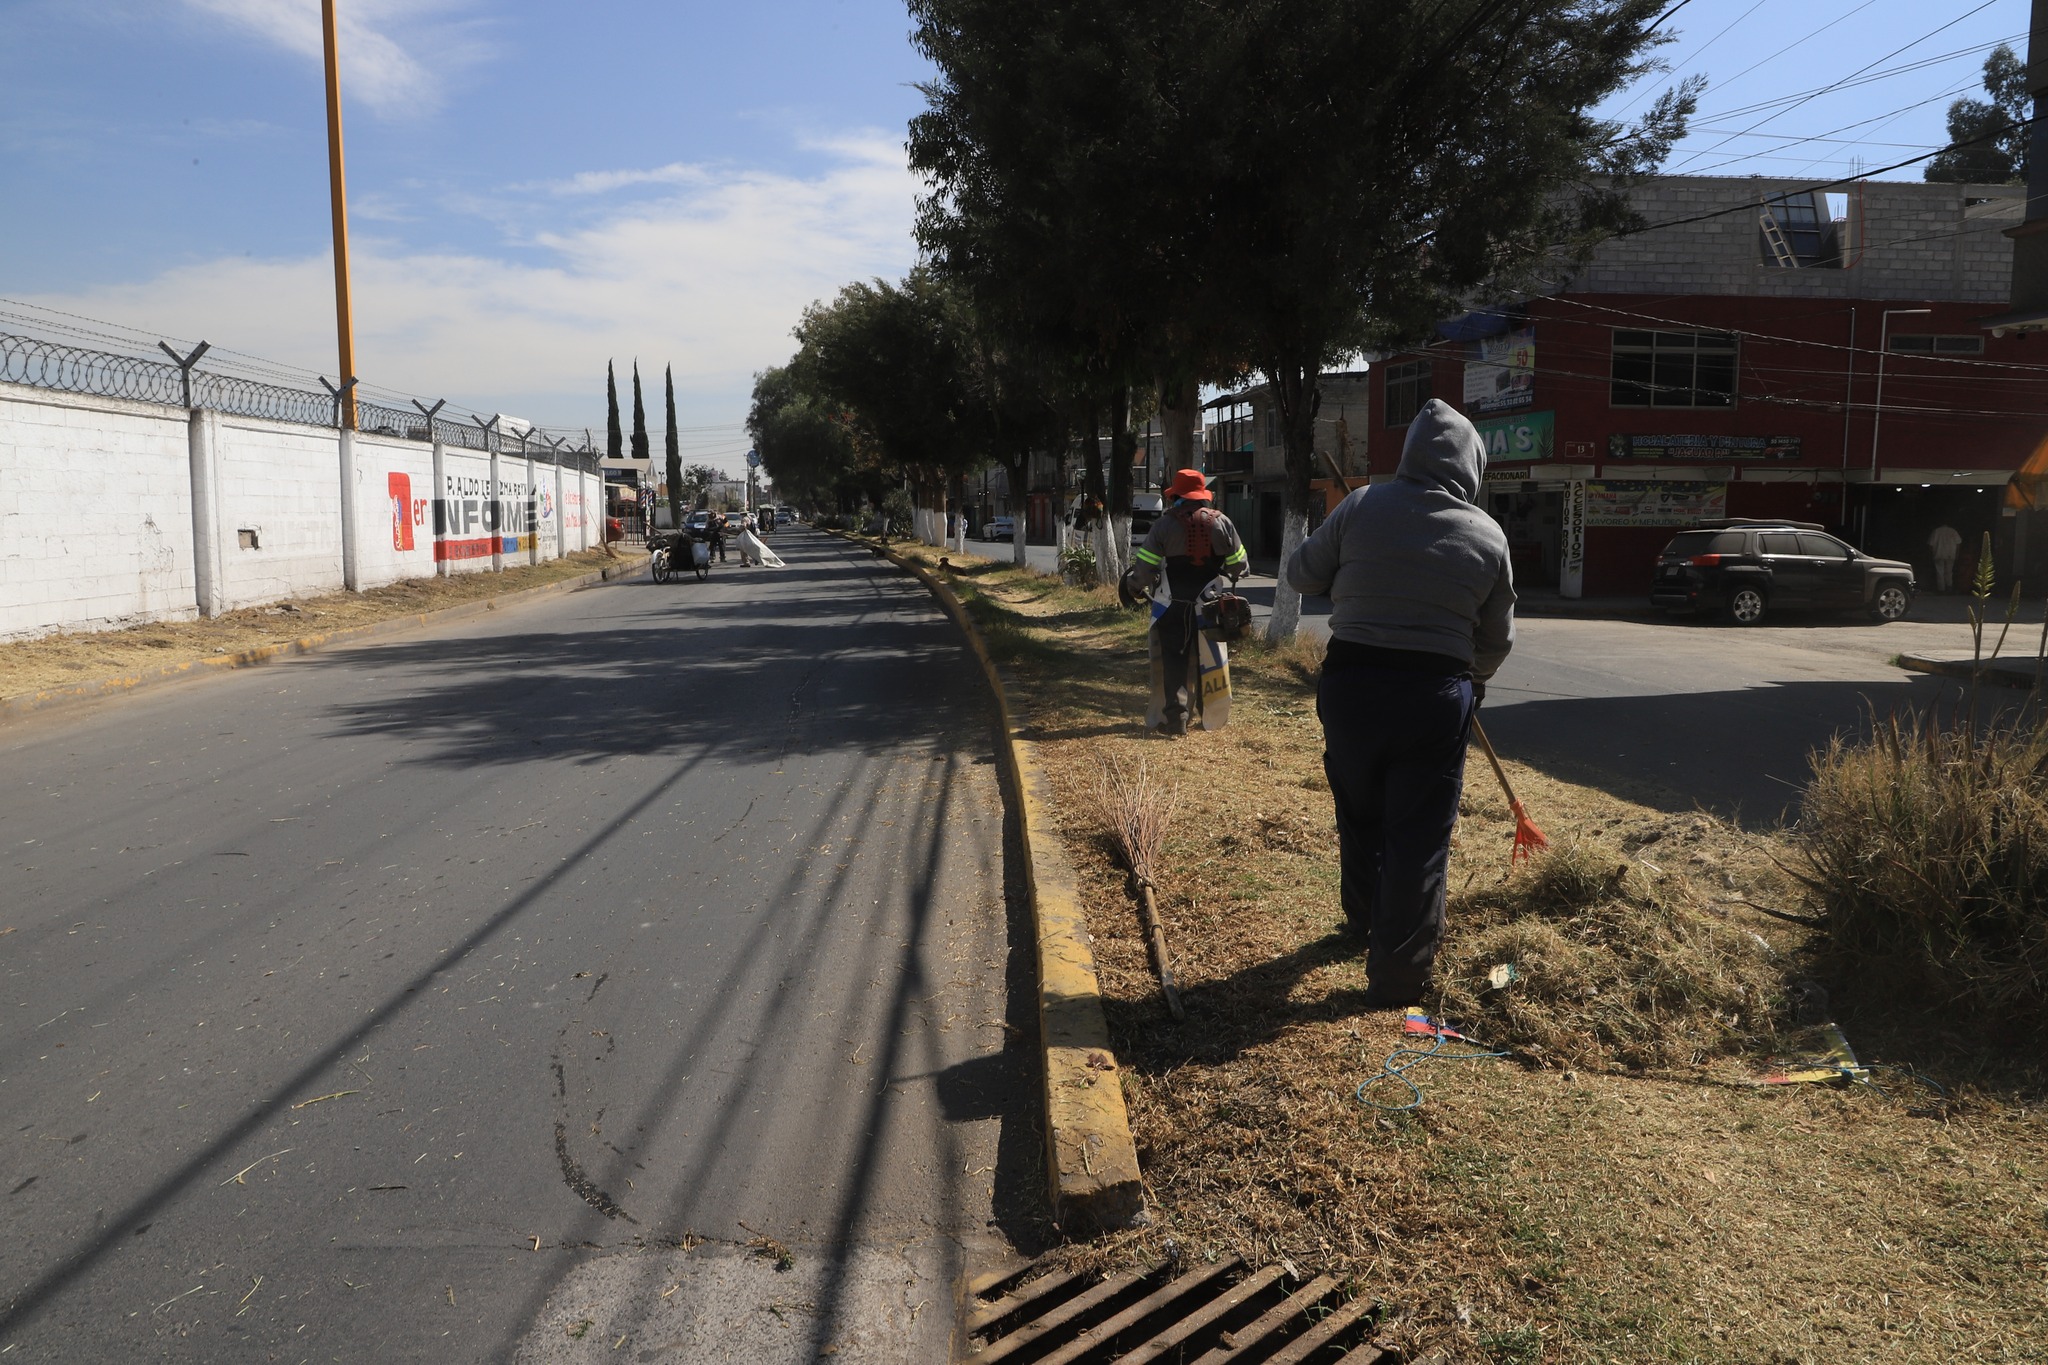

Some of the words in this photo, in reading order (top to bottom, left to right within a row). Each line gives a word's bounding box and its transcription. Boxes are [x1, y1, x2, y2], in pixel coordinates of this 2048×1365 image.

[1516, 349, 1528, 367] 50
[1483, 471, 1527, 481] EFACCIONARI
[457, 477, 479, 499] ALDO
[431, 499, 538, 535] INFORME
[1571, 481, 1583, 559] ACCESORIOS
